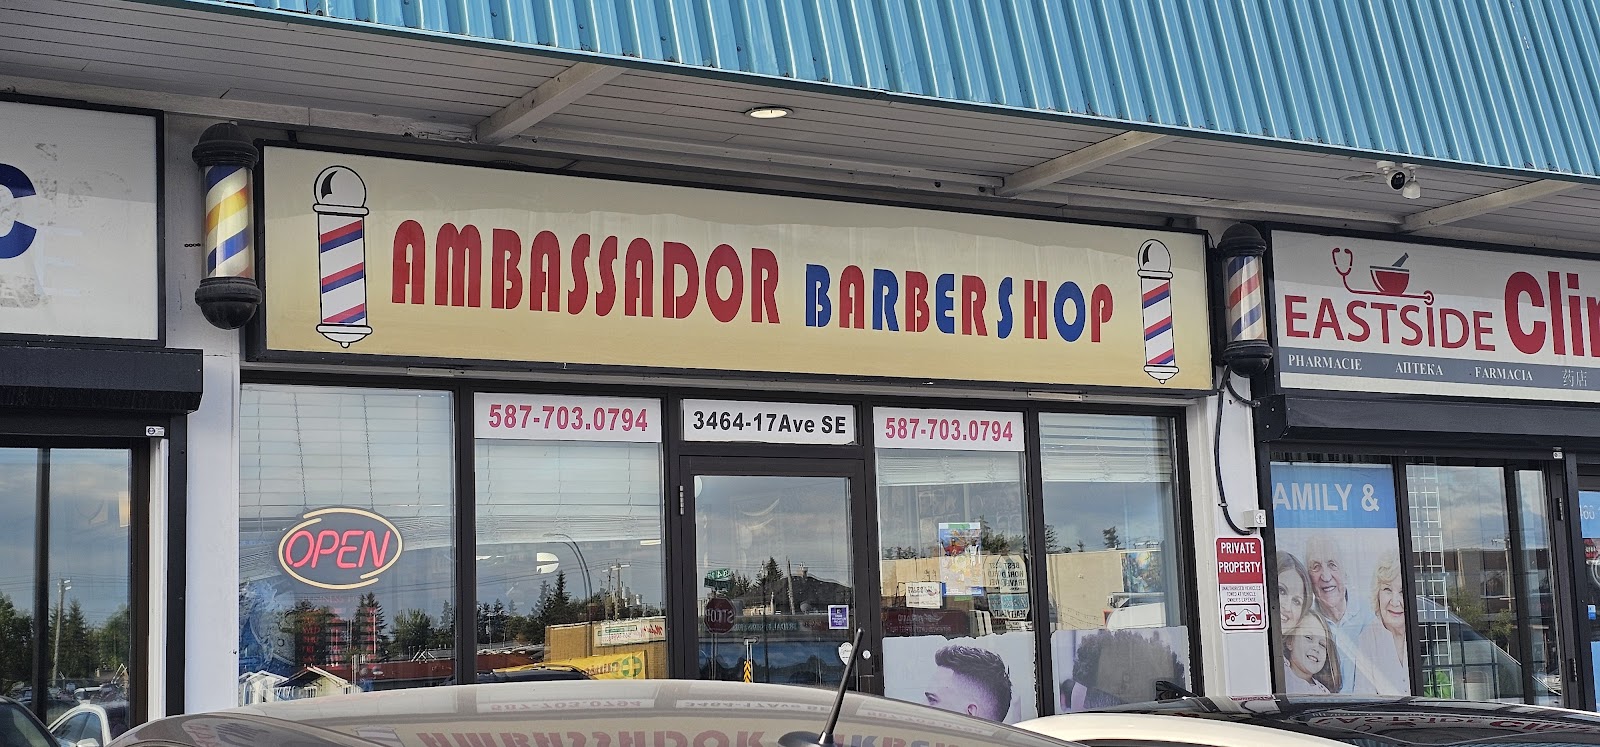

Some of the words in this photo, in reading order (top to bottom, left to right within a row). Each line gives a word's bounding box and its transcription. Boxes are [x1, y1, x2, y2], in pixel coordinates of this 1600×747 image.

[391, 219, 781, 324] AMBASSADOR
[1284, 294, 1496, 352] EASTSIDE
[1288, 353, 1362, 371] PHARMACIE
[1395, 361, 1444, 376] АПТЕКА
[1474, 365, 1533, 382] FARMACIA
[488, 404, 648, 432] 587-703.0794
[692, 410, 815, 434] 3464-17Ave
[821, 415, 846, 434] SE
[885, 416, 1013, 442] 587-703.0794
[1273, 482, 1353, 511] AMILY
[1361, 483, 1380, 512] &
[285, 530, 391, 569] OPEN
[1220, 542, 1256, 554] PRIVATE
[1218, 561, 1261, 573] PROPERTY
